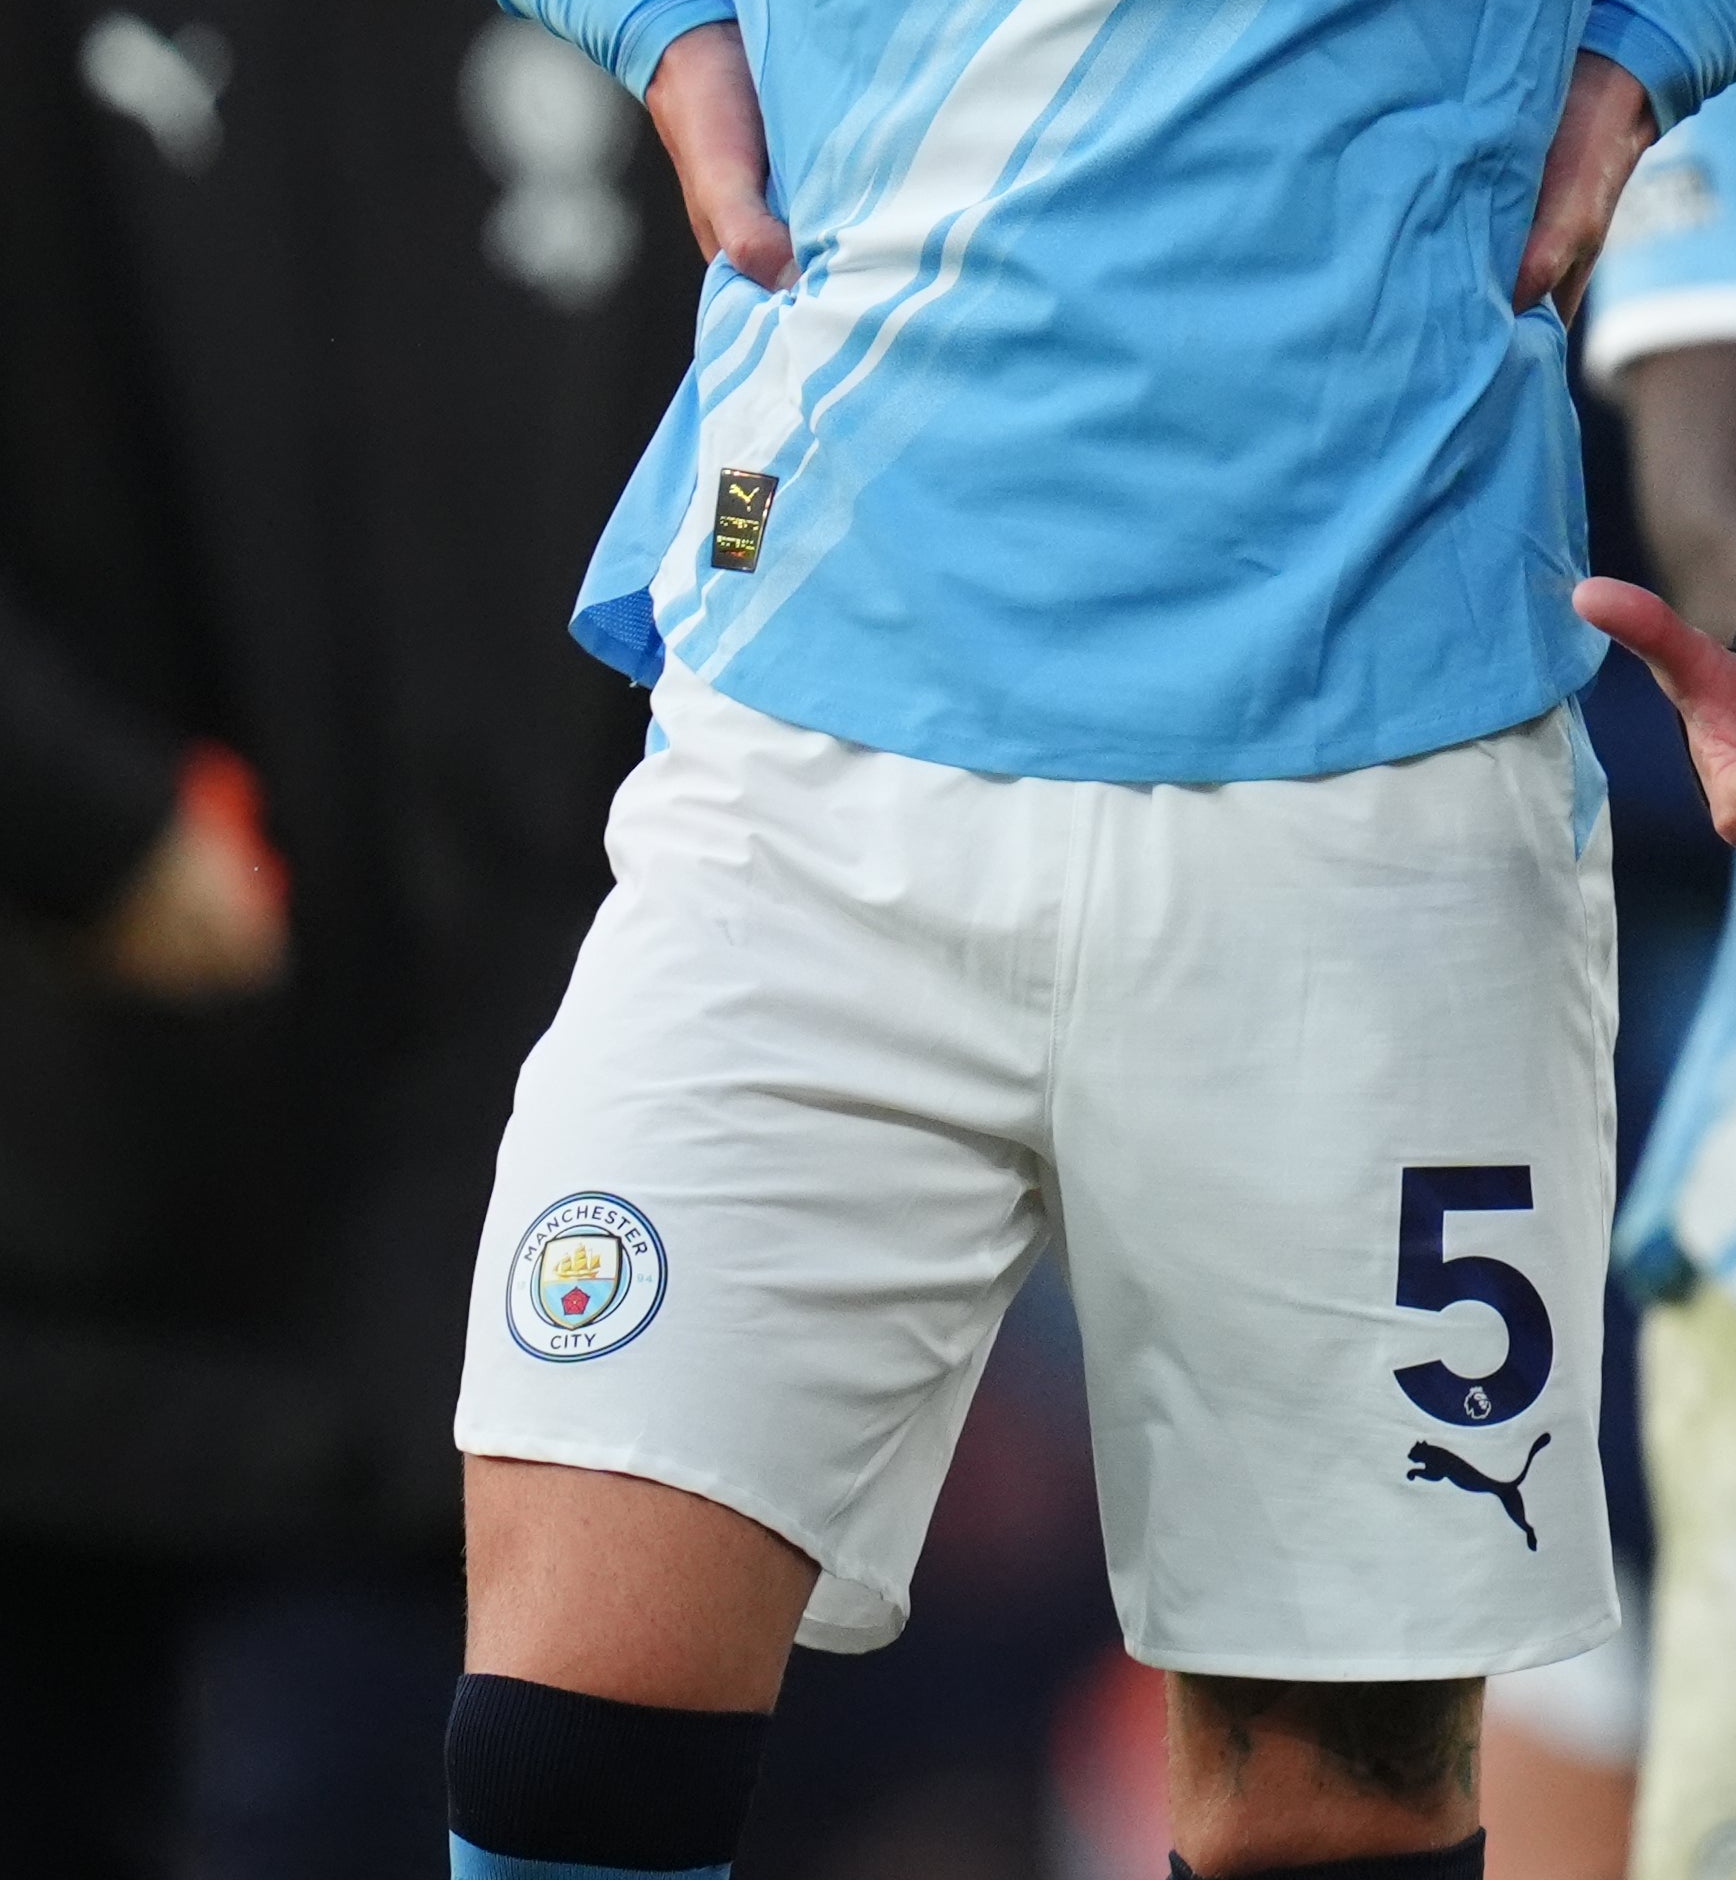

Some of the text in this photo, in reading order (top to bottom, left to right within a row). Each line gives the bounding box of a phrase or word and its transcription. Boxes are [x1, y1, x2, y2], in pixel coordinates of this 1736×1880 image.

[523, 1204, 648, 1263] MANCHESTER
[1393, 1164, 1554, 1428] 5
[550, 1332, 597, 1350] CITY
